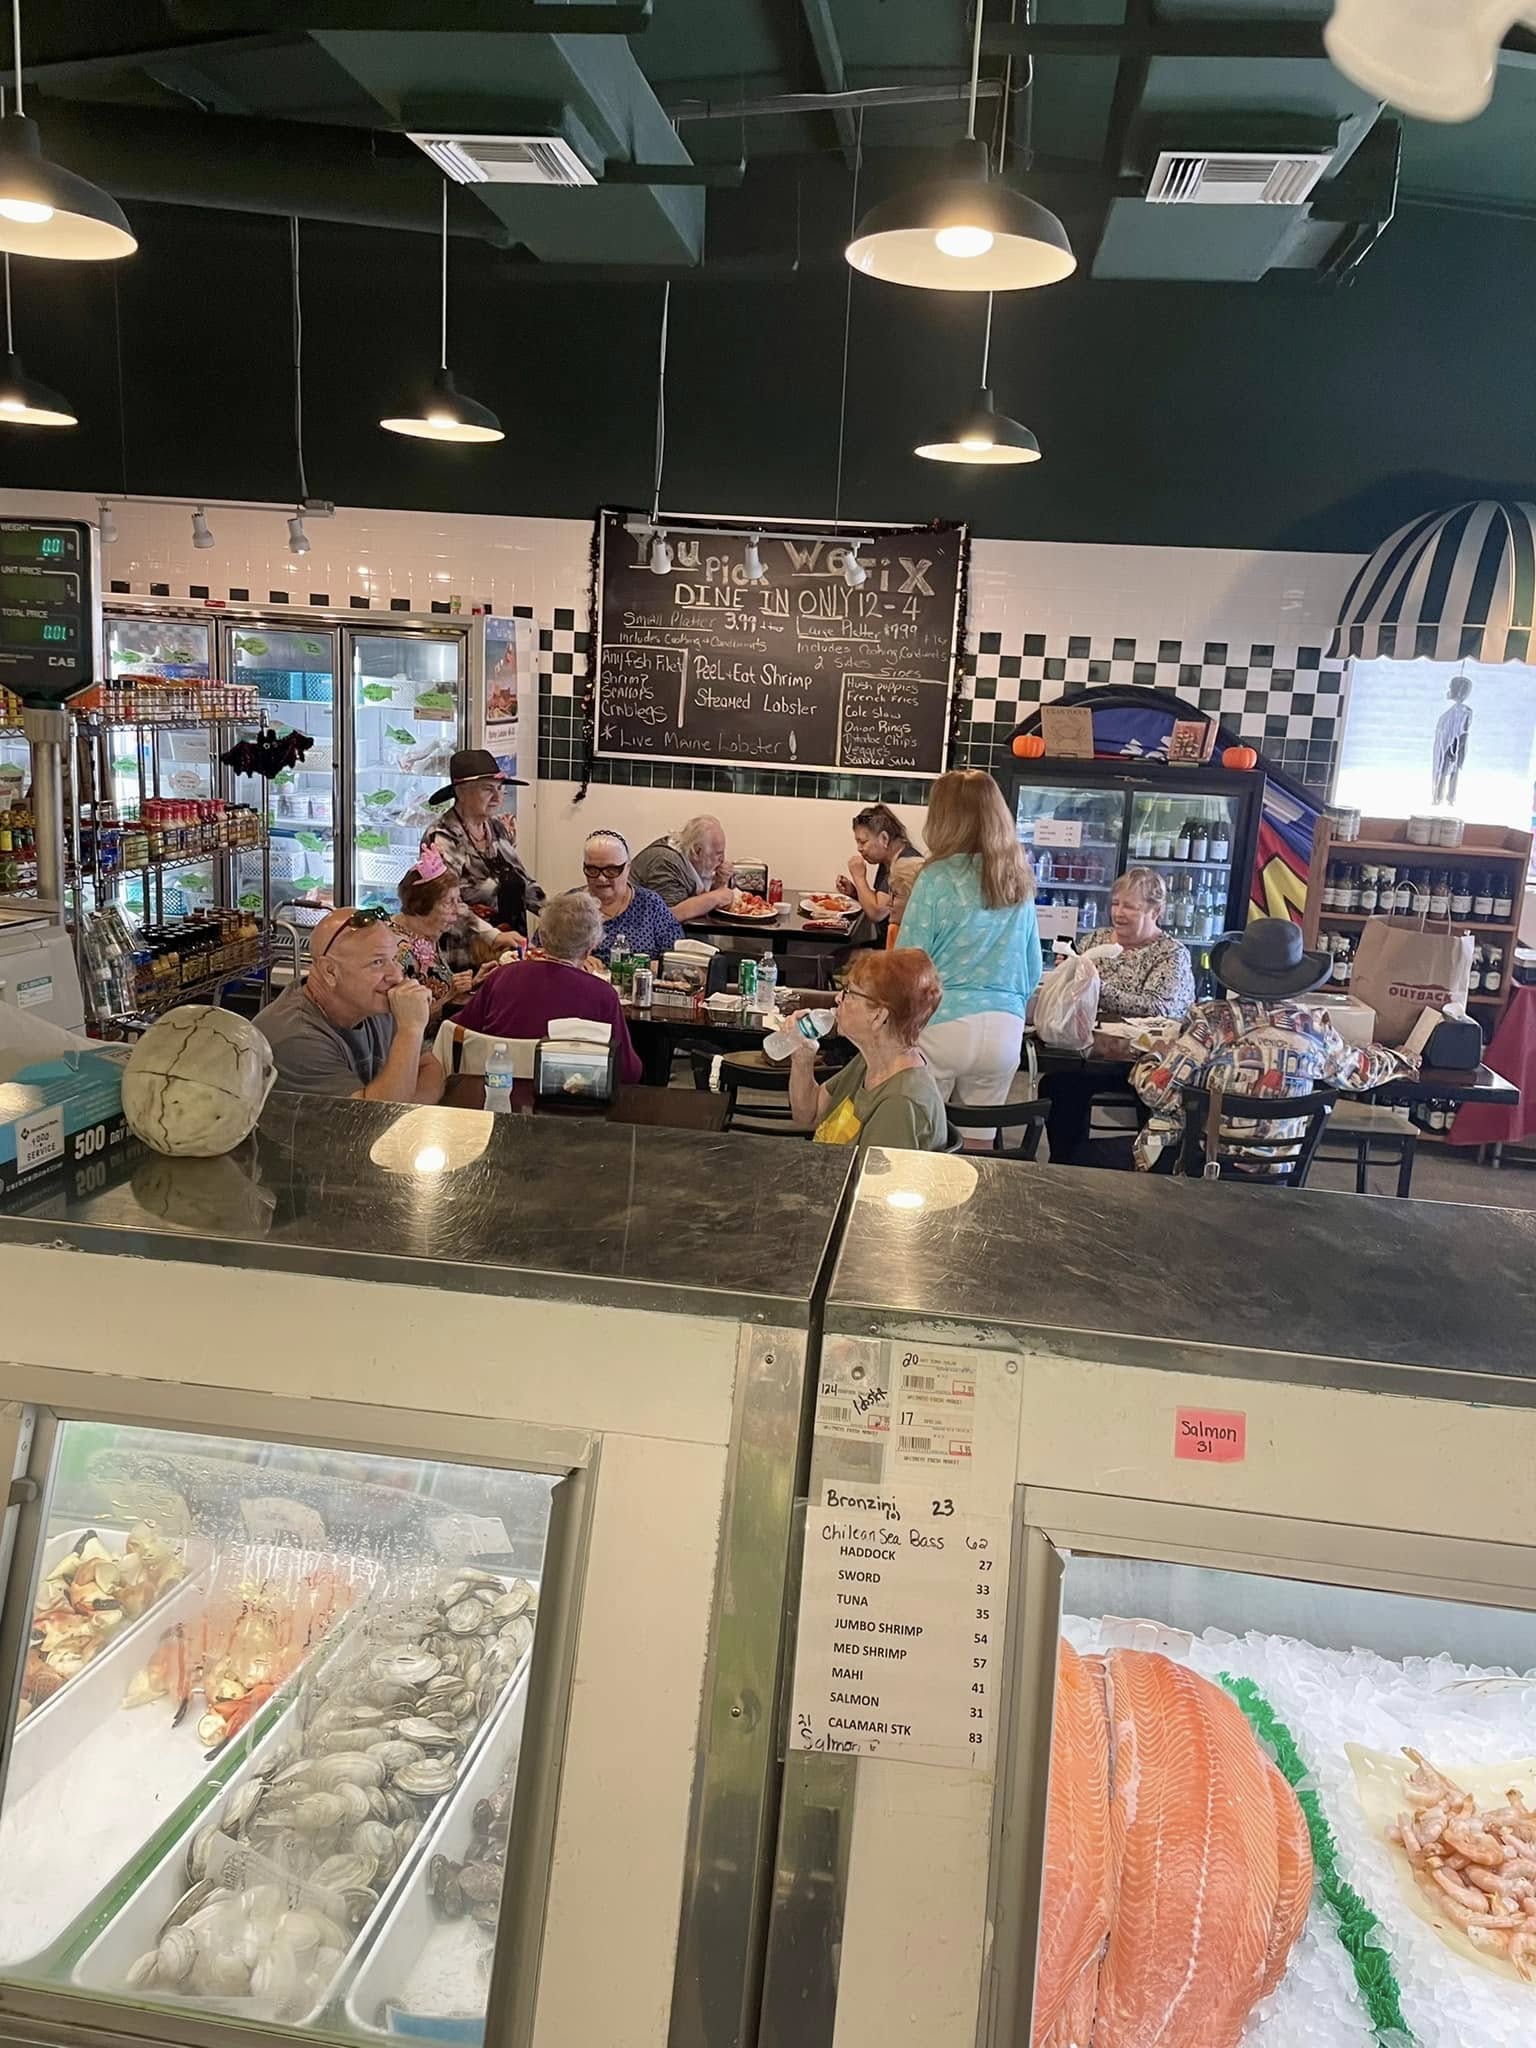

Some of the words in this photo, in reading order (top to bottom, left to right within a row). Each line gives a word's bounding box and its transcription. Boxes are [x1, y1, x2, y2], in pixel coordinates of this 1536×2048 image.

[20, 566, 42, 576] PRICE
[674, 583, 749, 609] DINE
[759, 588, 790, 614] IN
[799, 584, 854, 617] ONLY
[2, 607, 25, 617] TOTAL
[26, 609, 49, 619] PRICE
[623, 611, 663, 628] Small
[797, 641, 851, 655] Includes
[48, 656, 76, 667] CAS
[814, 655, 825, 670] 2
[760, 663, 813, 690] Shrimp
[763, 690, 818, 716] Lobster
[845, 704, 867, 718] Cole
[719, 732, 781, 755] Lobster
[1389, 986, 1453, 1003] OUTBACK
[27, 1142, 56, 1162] SERVICE
[74, 1124, 106, 1160] 500
[902, 1352, 919, 1368] 20
[821, 1383, 838, 1397] 124
[900, 1411, 914, 1426] 17
[1181, 1420, 1237, 1442] Salmon
[1197, 1440, 1212, 1453] 31
[827, 1489, 897, 1512] Bronzini
[932, 1499, 955, 1516] 23
[879, 1527, 902, 1546] Sea
[909, 1528, 945, 1550] Bass
[965, 1536, 989, 1550] 62
[840, 1546, 896, 1561] HADDOCK
[979, 1559, 993, 1571] 27
[838, 1569, 881, 1584] SWORD
[976, 1583, 991, 1595] 33
[837, 1593, 869, 1607] TUNA
[976, 1608, 990, 1620] 35
[834, 1618, 876, 1632] JUMBO
[878, 1623, 924, 1637] SHRIMP
[974, 1633, 988, 1645] 54
[833, 1642, 860, 1655] MED
[862, 1645, 908, 1660] SHRIMP
[973, 1658, 988, 1669] 57
[831, 1667, 864, 1681] MAHI
[971, 1682, 985, 1694] 41
[830, 1691, 880, 1707] SALMON
[970, 1707, 984, 1719] 31
[828, 1716, 888, 1734] CALAMARI
[890, 1723, 912, 1736] STK
[968, 1732, 983, 1744] 83
